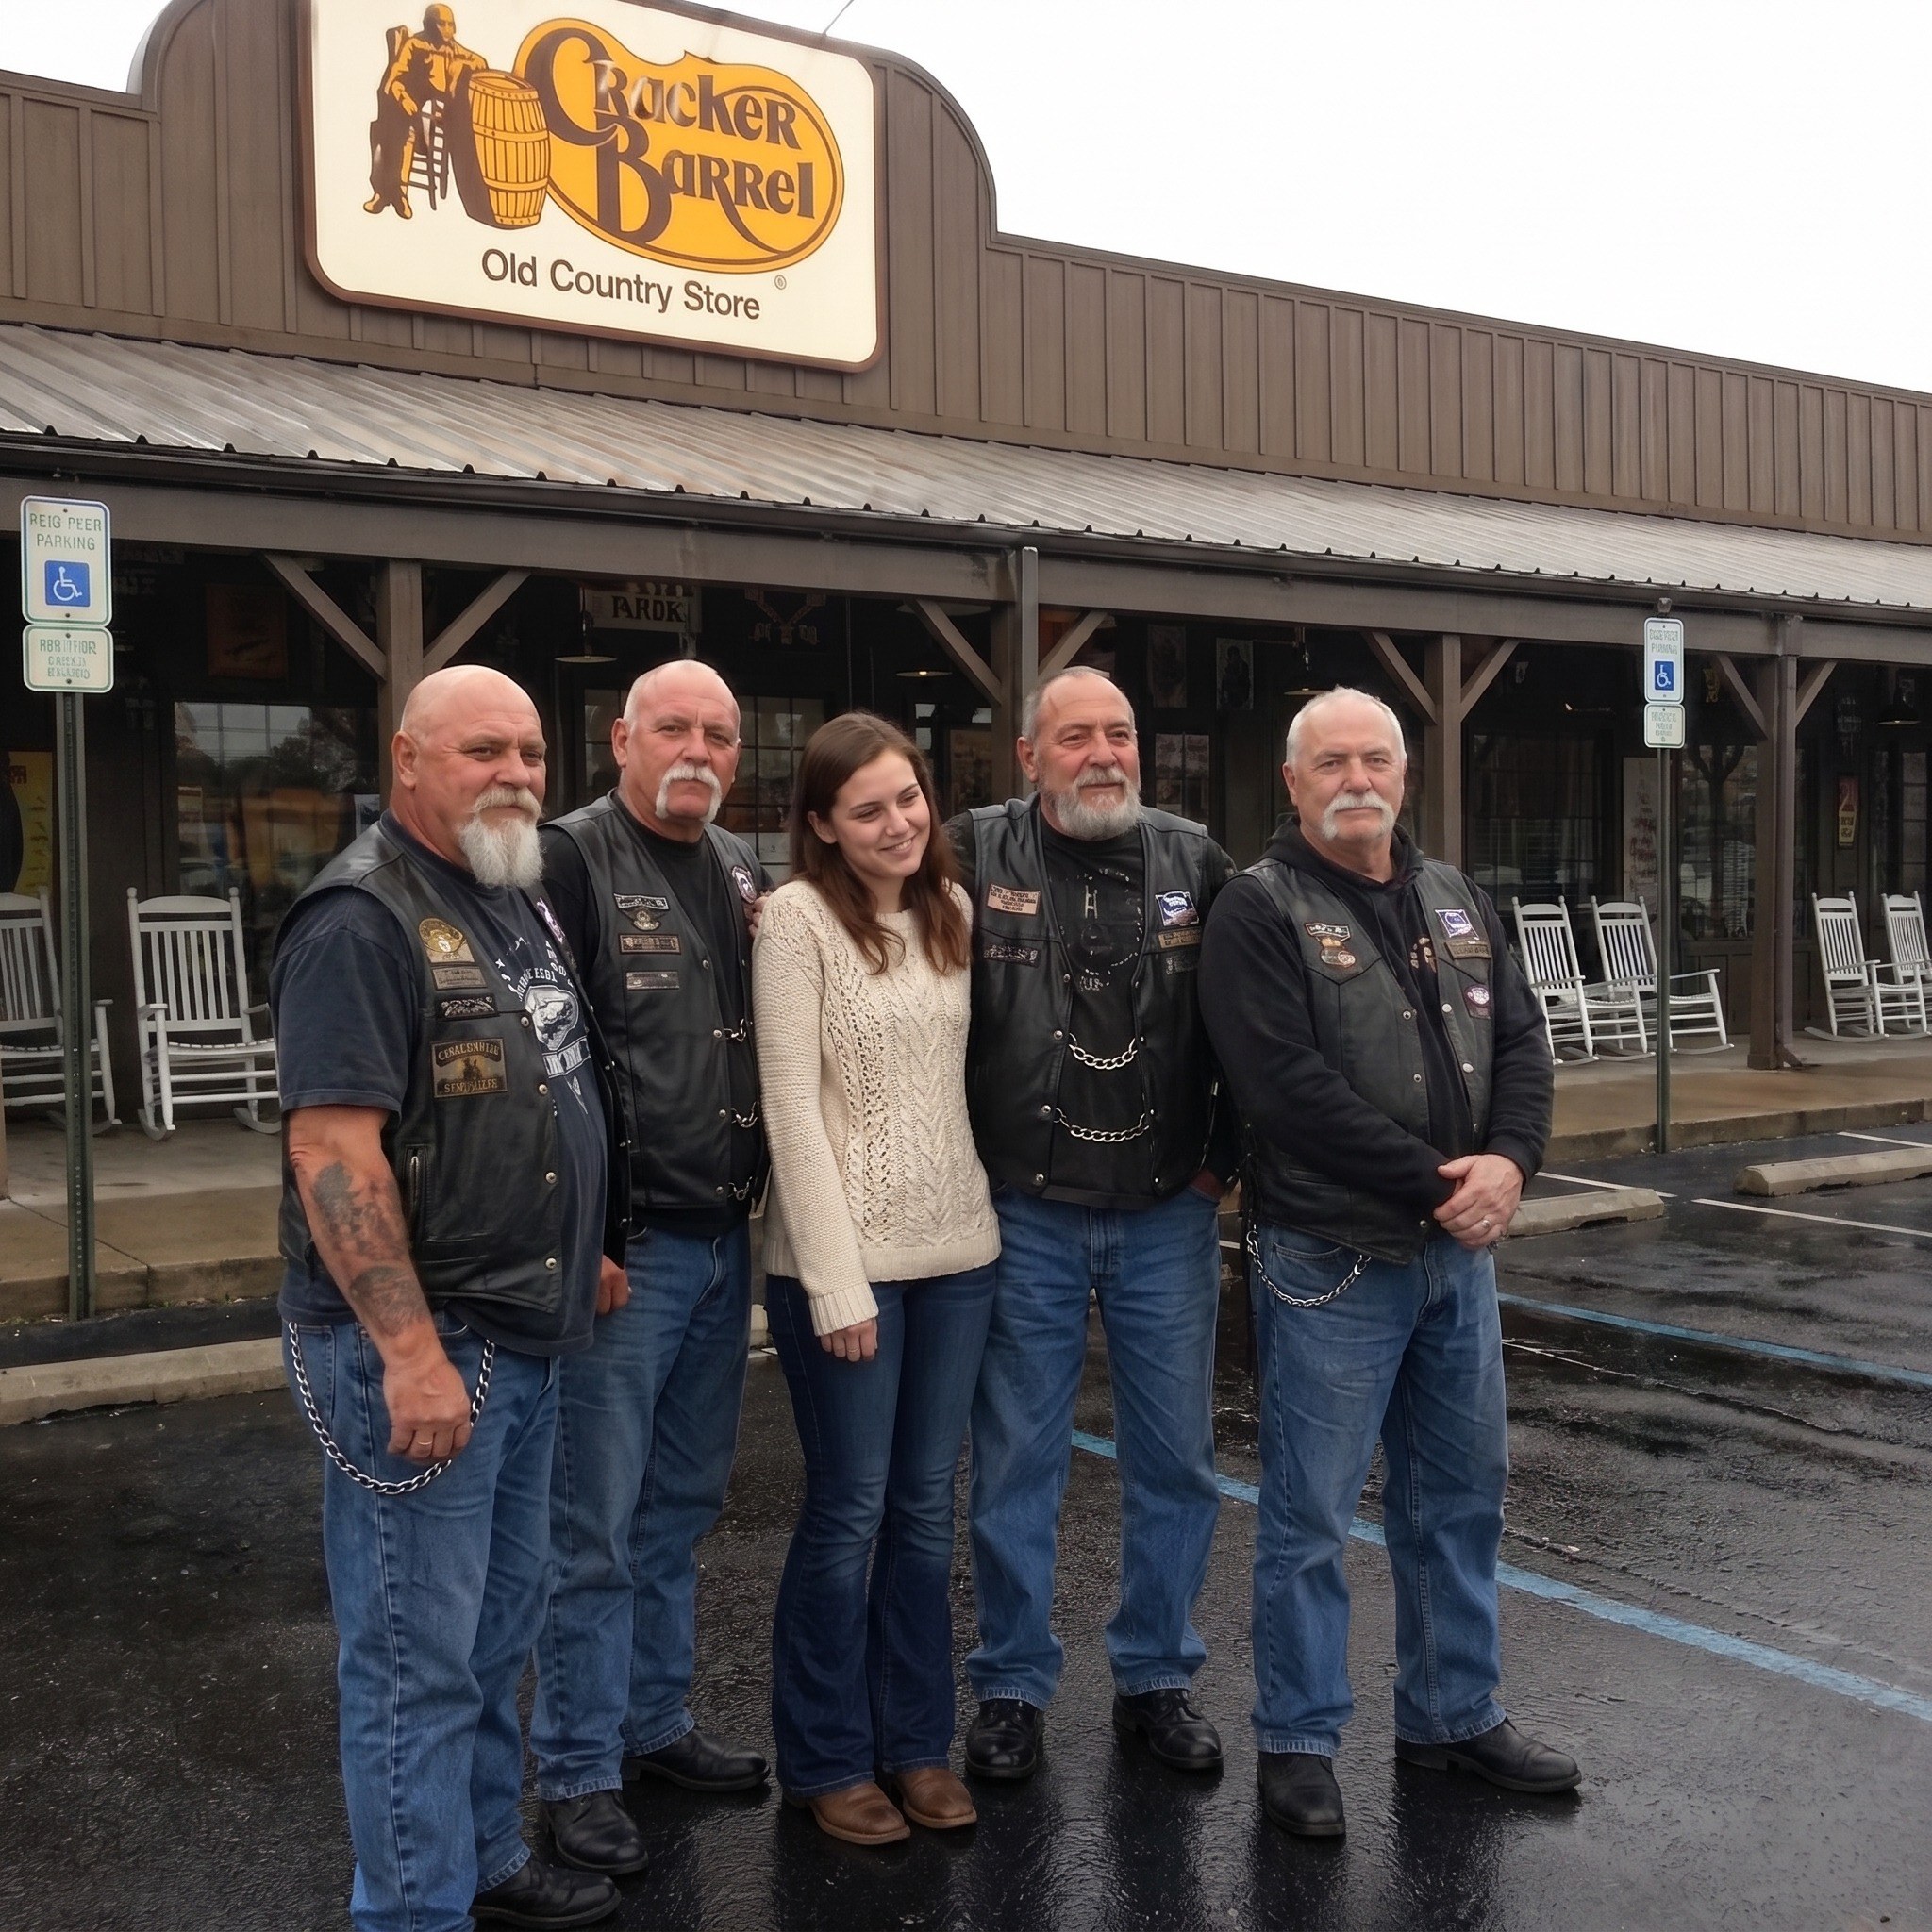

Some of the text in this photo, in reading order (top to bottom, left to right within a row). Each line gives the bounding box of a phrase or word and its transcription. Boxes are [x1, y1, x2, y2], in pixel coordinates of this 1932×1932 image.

[525, 27, 803, 150] Cracker
[595, 110, 816, 253] Barrel
[482, 249, 760, 320] Old Country Store
[37, 534, 95, 550] PARKING
